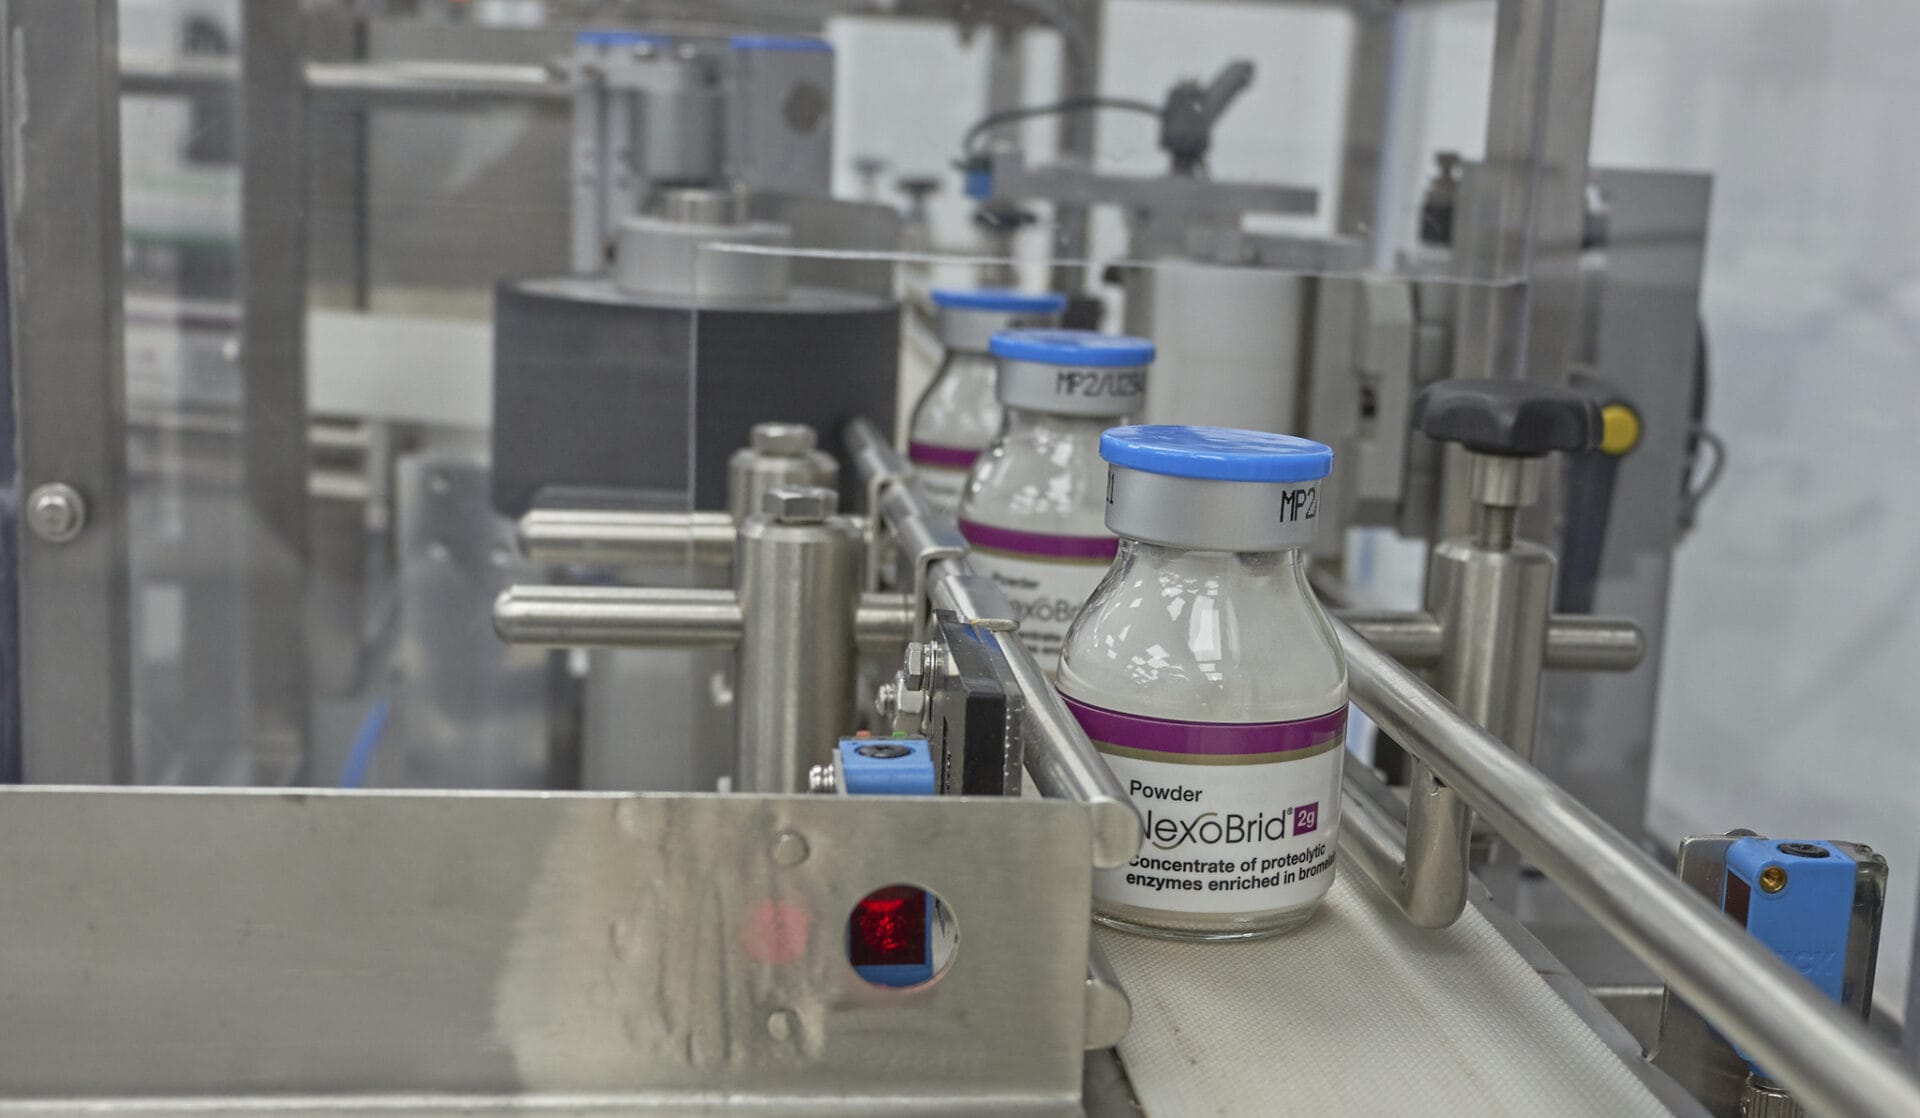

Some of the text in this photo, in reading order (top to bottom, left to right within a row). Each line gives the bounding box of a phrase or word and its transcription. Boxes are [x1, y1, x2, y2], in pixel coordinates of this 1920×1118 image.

[1130, 780, 1203, 803] Powder
[1297, 809, 1315, 828] 2g
[1240, 857, 1257, 873] of
[1261, 843, 1326, 873] proteolytic
[1126, 872, 1203, 892] enzymes
[1208, 872, 1280, 890] enriched
[1283, 871, 1295, 884] in
